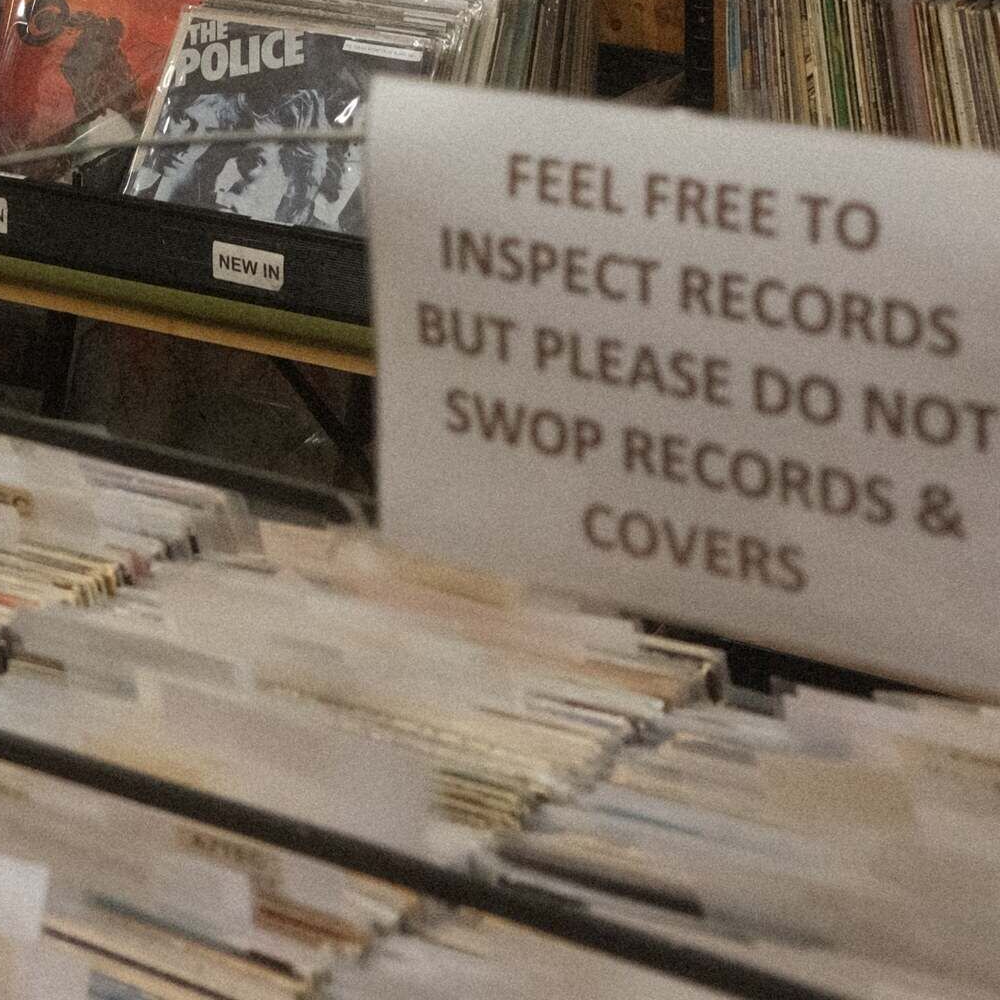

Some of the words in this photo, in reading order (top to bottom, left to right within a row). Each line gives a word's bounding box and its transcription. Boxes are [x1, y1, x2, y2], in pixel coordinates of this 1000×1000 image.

[174, 28, 304, 88] POLICE
[189, 20, 228, 46] THE
[505, 151, 625, 216] FEEL
[643, 172, 777, 239] FREE
[799, 194, 883, 253] TO
[218, 253, 258, 276] NEW
[263, 261, 280, 281] IN
[438, 225, 662, 306] INSPECT
[677, 262, 963, 359] RECORDS
[415, 302, 518, 368] BUT
[532, 324, 734, 409] PLEASE
[750, 364, 843, 426] DO
[862, 385, 1000, 455] NOT
[443, 388, 603, 465] SWOP
[621, 425, 900, 527] RECORDS
[915, 482, 968, 541] &
[581, 503, 810, 595] COVERS
